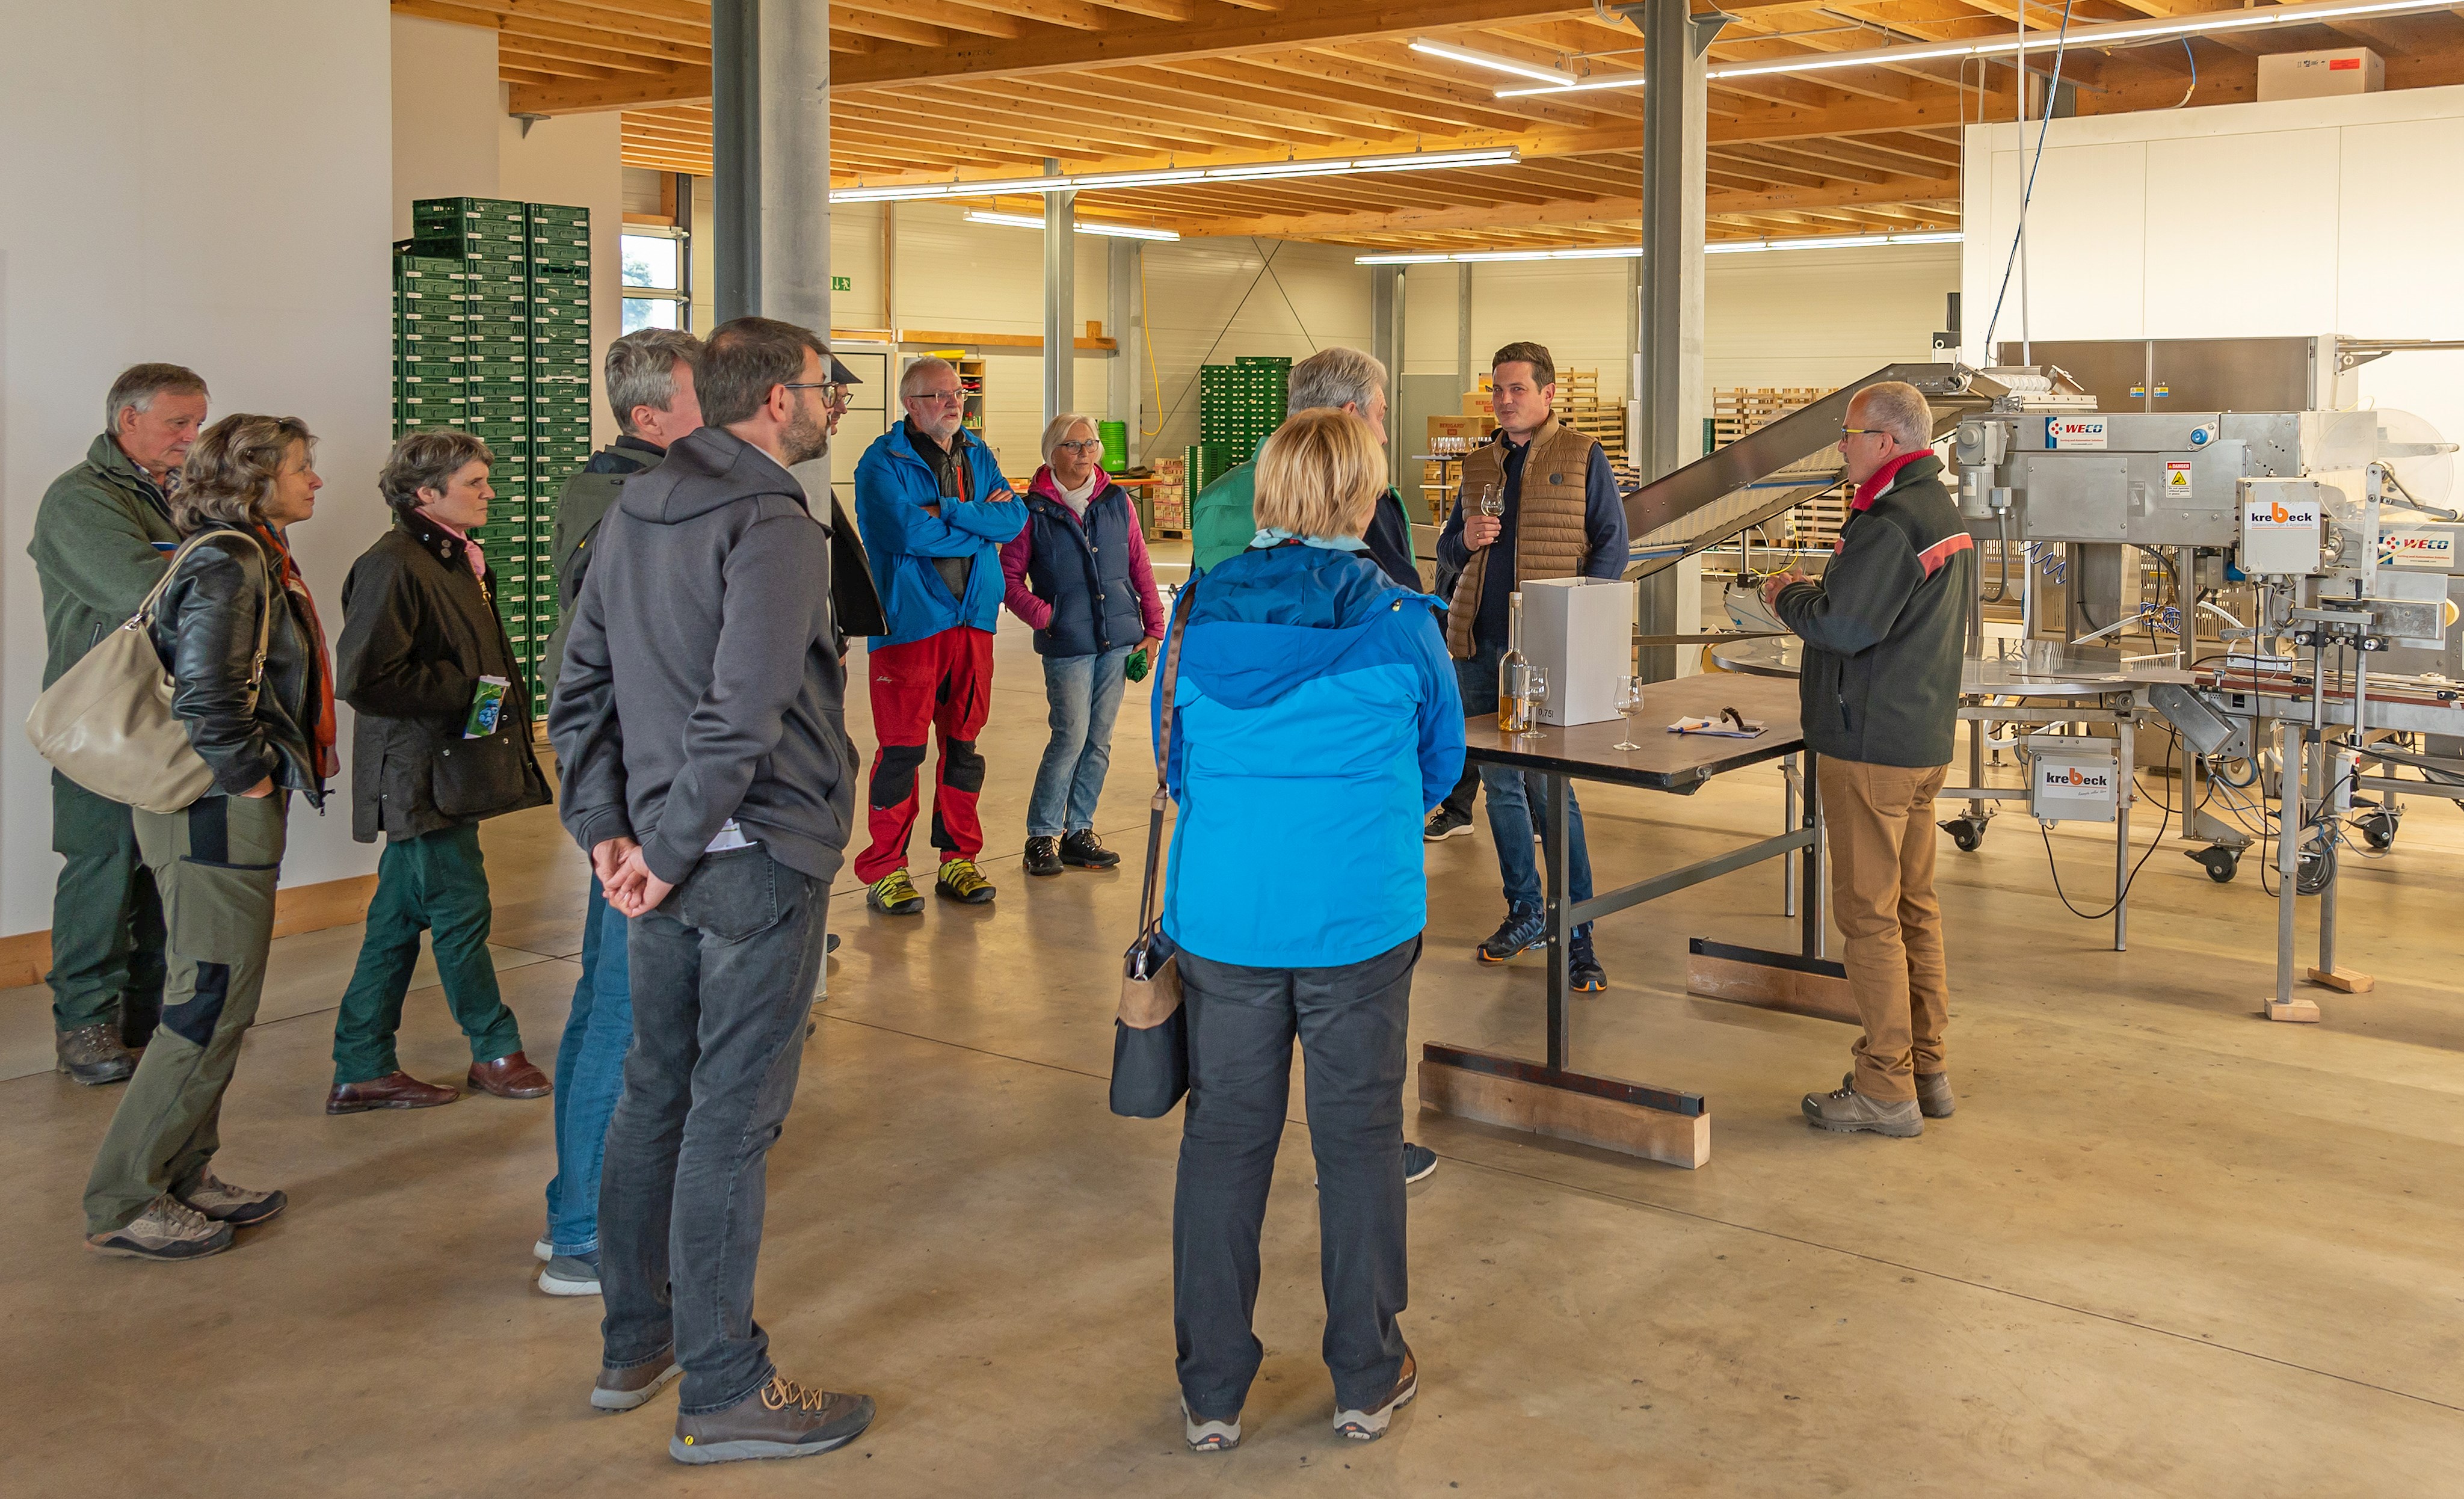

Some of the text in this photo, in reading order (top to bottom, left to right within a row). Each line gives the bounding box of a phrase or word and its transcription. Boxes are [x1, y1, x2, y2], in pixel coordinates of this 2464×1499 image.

[2066, 425, 2103, 433] WECO
[2252, 502, 2312, 523] krebeck
[2404, 539, 2449, 549] WECO
[1538, 708, 1554, 718] 0,75l
[2047, 768, 2107, 786] krebeck
